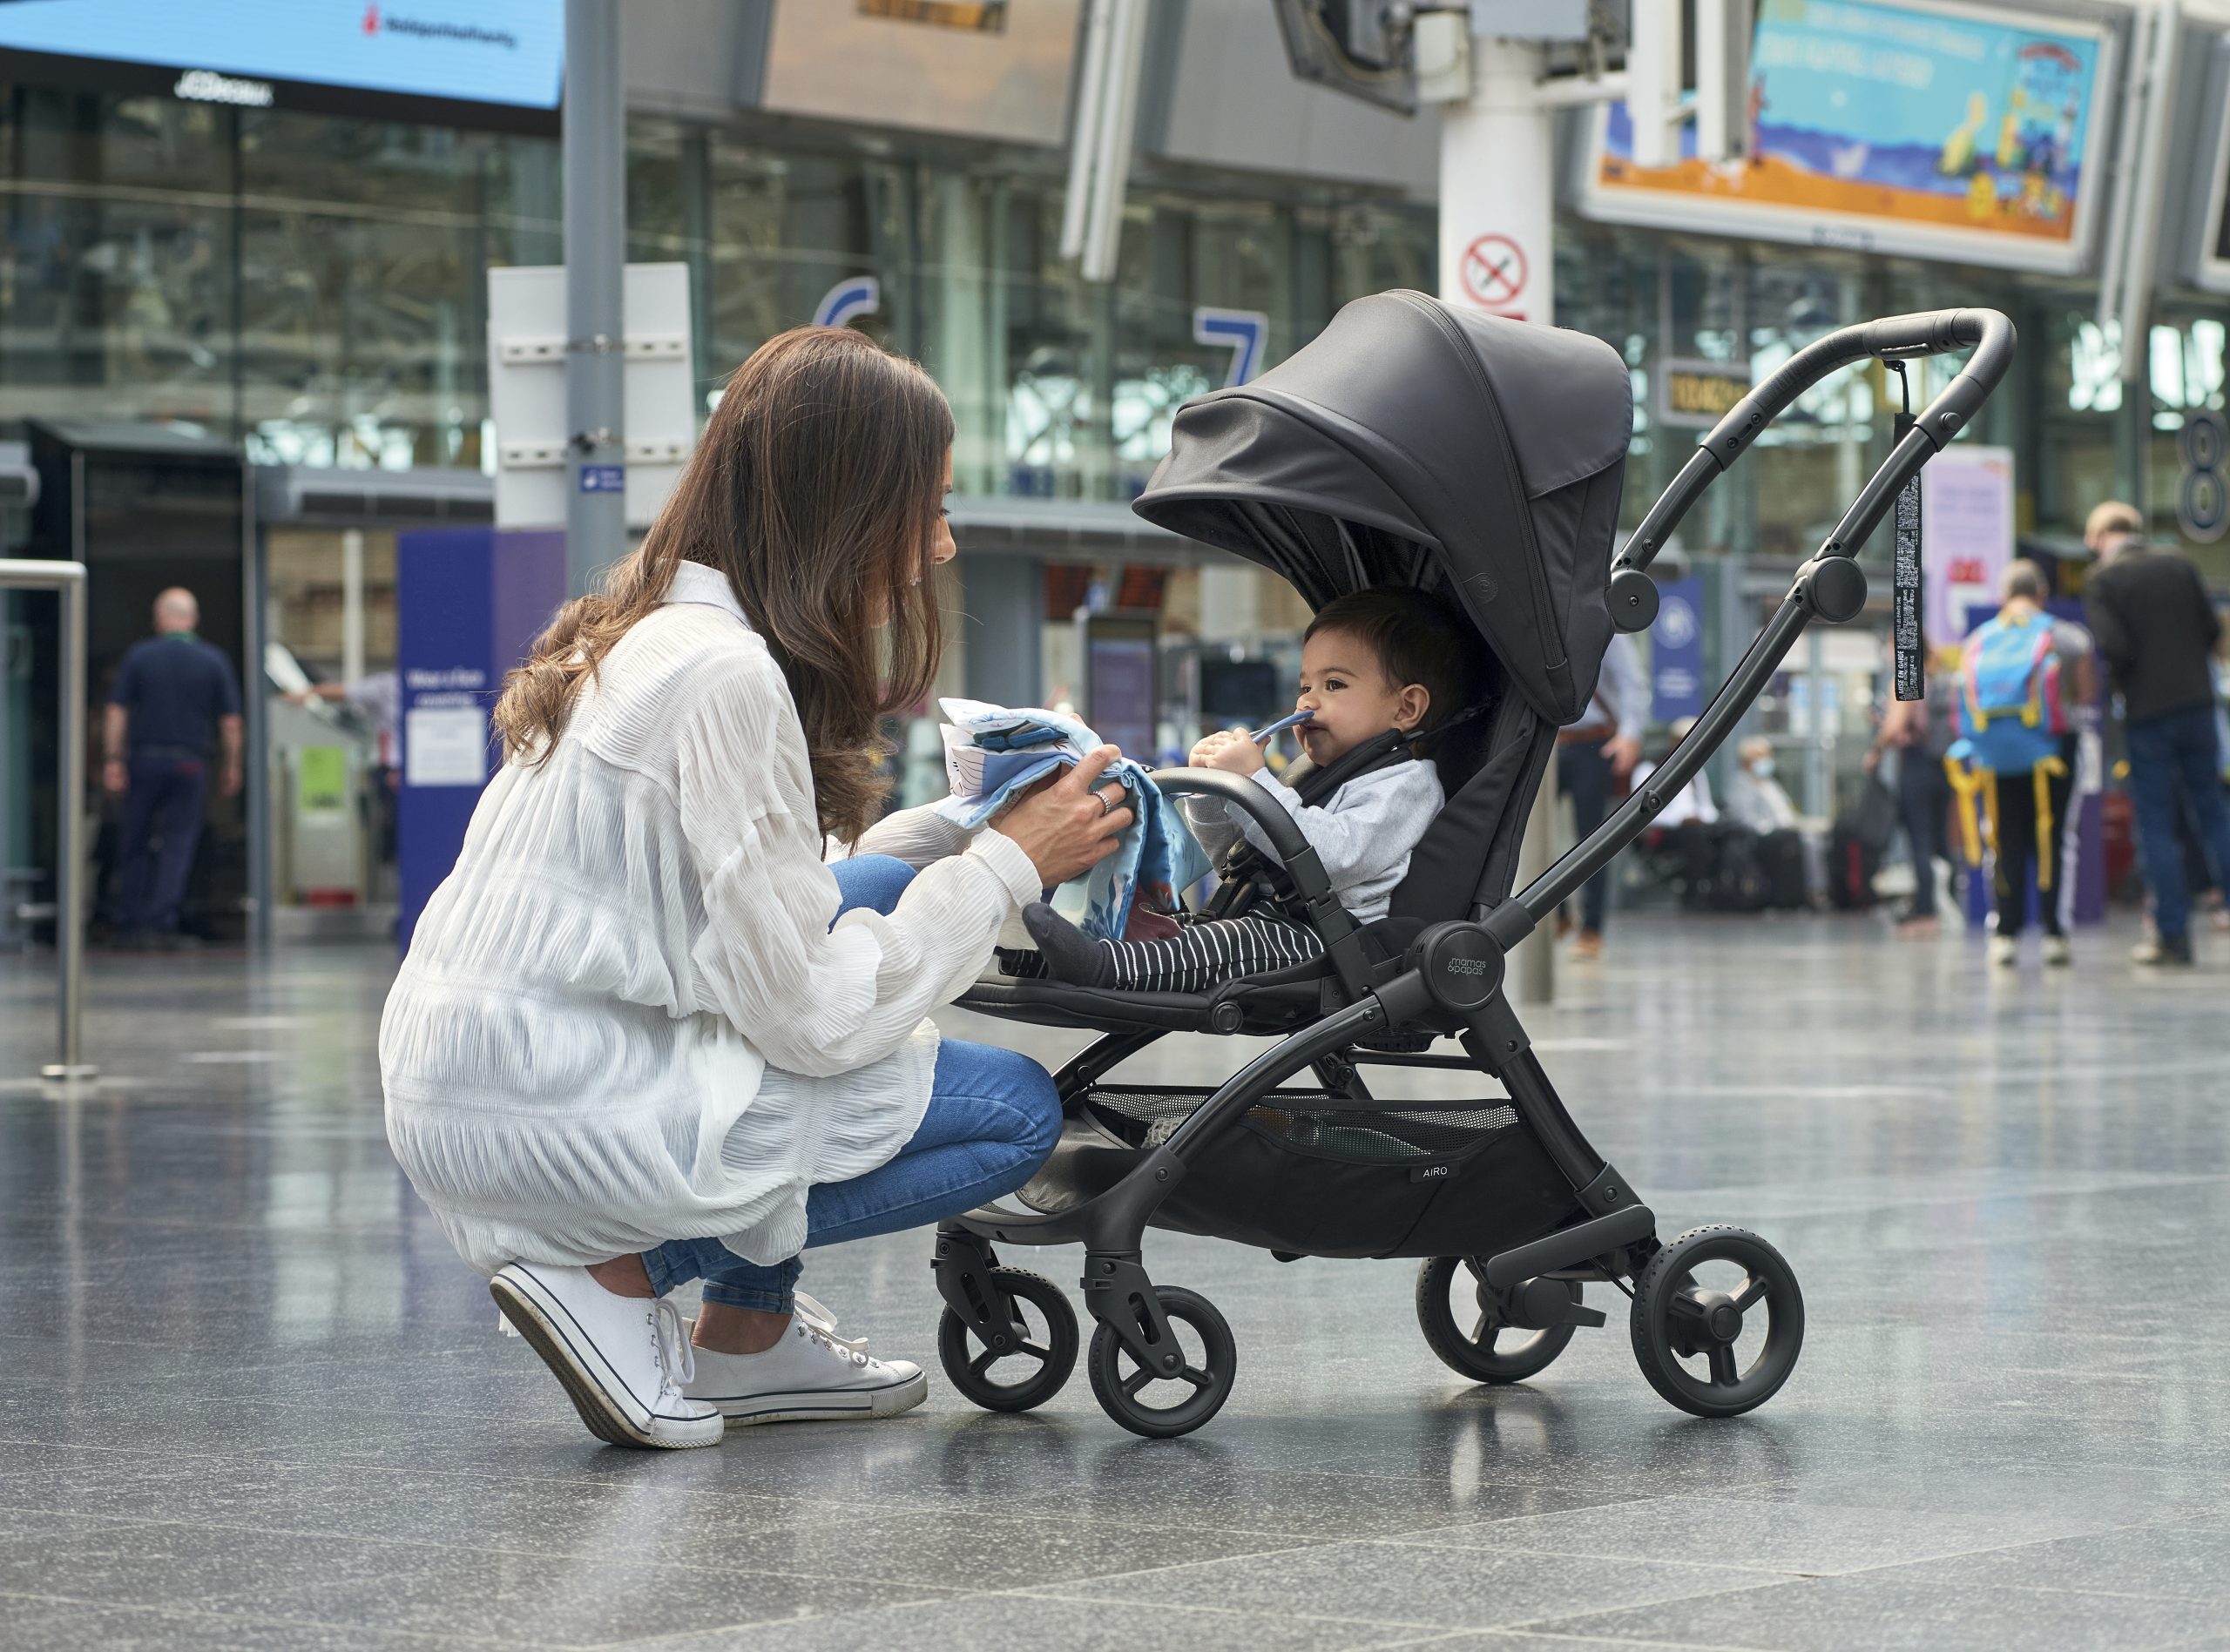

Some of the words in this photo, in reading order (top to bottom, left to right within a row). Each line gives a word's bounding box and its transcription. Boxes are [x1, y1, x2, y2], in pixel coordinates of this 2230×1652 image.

[1193, 307, 1268, 387] 7
[2174, 407, 2230, 545] 8
[1897, 670, 1904, 678] EN
[1451, 958, 1486, 968] mamas
[1422, 1166, 1448, 1177] AIRO
